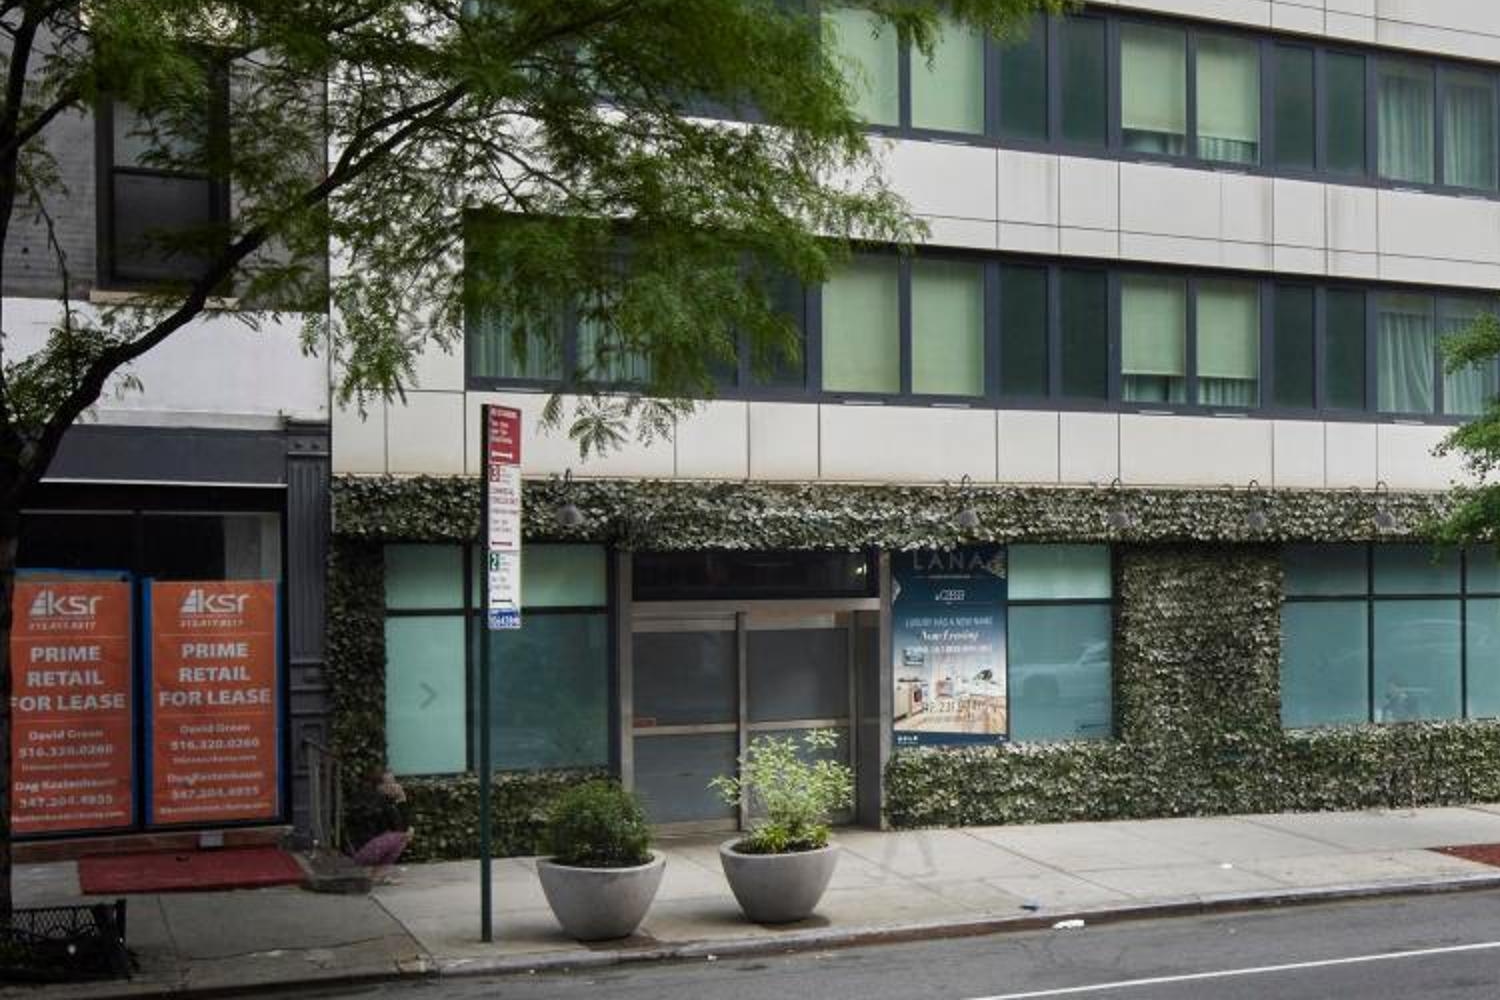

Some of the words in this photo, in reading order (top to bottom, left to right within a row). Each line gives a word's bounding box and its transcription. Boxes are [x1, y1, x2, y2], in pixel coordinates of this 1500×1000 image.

[30, 645, 101, 663] PRIME
[181, 642, 249, 659] PRIME
[26, 669, 104, 687] RETAIL
[178, 666, 251, 683] RETAIL
[57, 693, 126, 711] LEASE
[159, 690, 203, 707] FOR
[206, 687, 271, 705] LEASE
